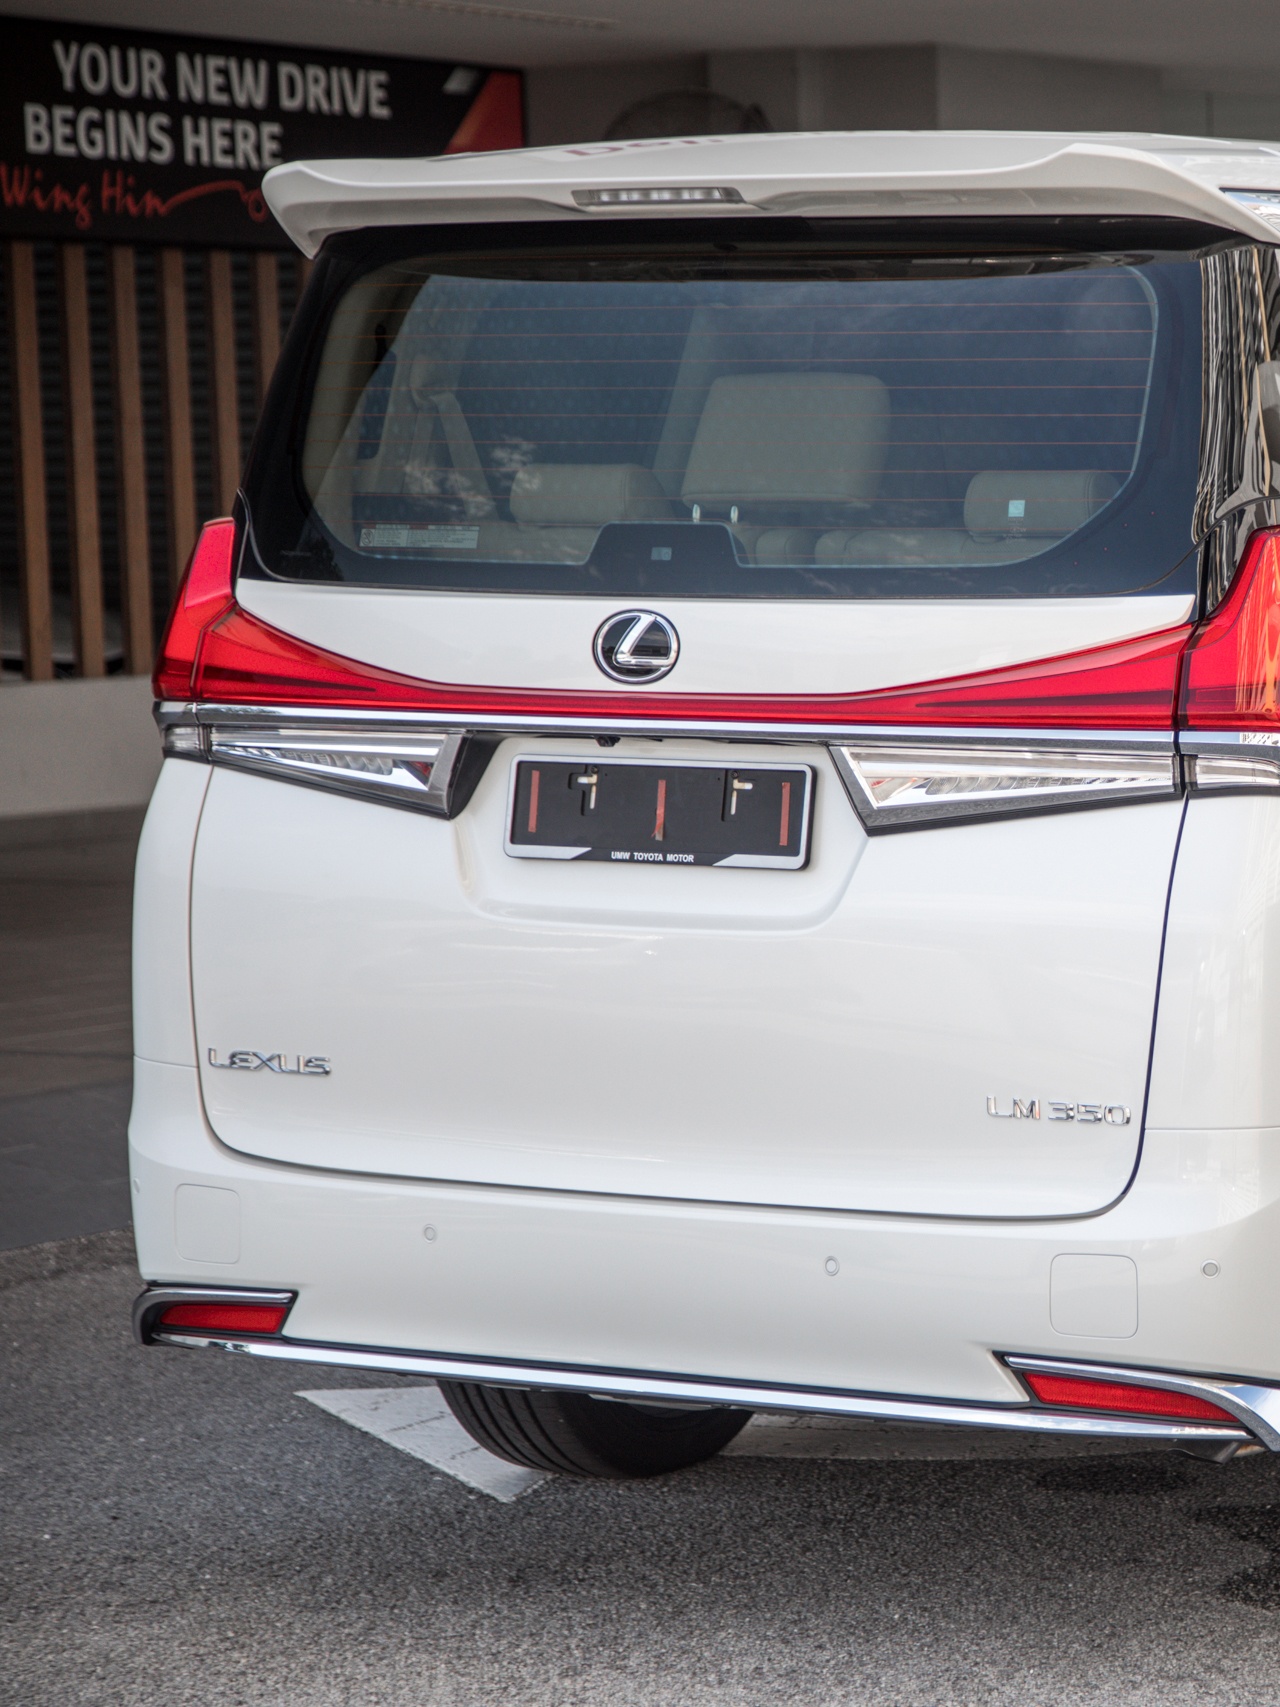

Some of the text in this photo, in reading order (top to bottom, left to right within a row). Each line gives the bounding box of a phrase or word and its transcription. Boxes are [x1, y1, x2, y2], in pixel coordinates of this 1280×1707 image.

[52, 39, 391, 119] YOUR NEW DRIVE
[23, 102, 284, 170] BEGINS HERE
[0, 160, 92, 230] Wing
[611, 851, 694, 862] UMW TOYOTA MOTOR
[208, 1048, 331, 1075] LEXUS
[986, 1095, 1131, 1126] LM 350
